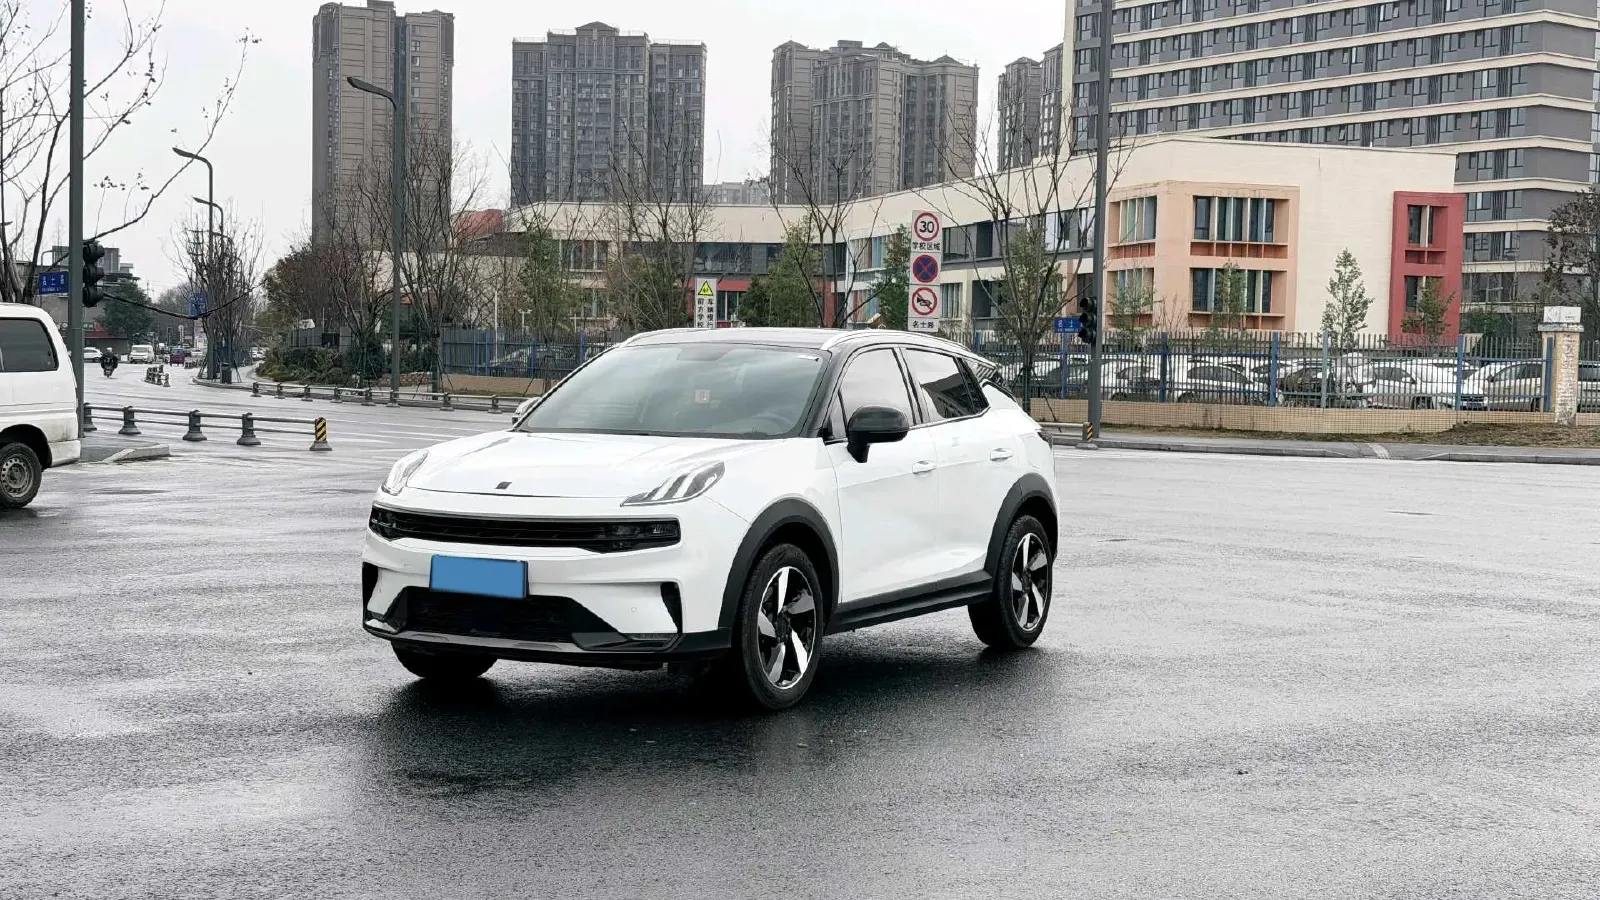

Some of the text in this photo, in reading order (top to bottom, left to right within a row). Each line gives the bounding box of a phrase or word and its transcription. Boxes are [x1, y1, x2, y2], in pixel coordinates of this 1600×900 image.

[919, 220, 935, 234] 30
[912, 241, 941, 251] 学校区域
[912, 320, 934, 329] 名士路
